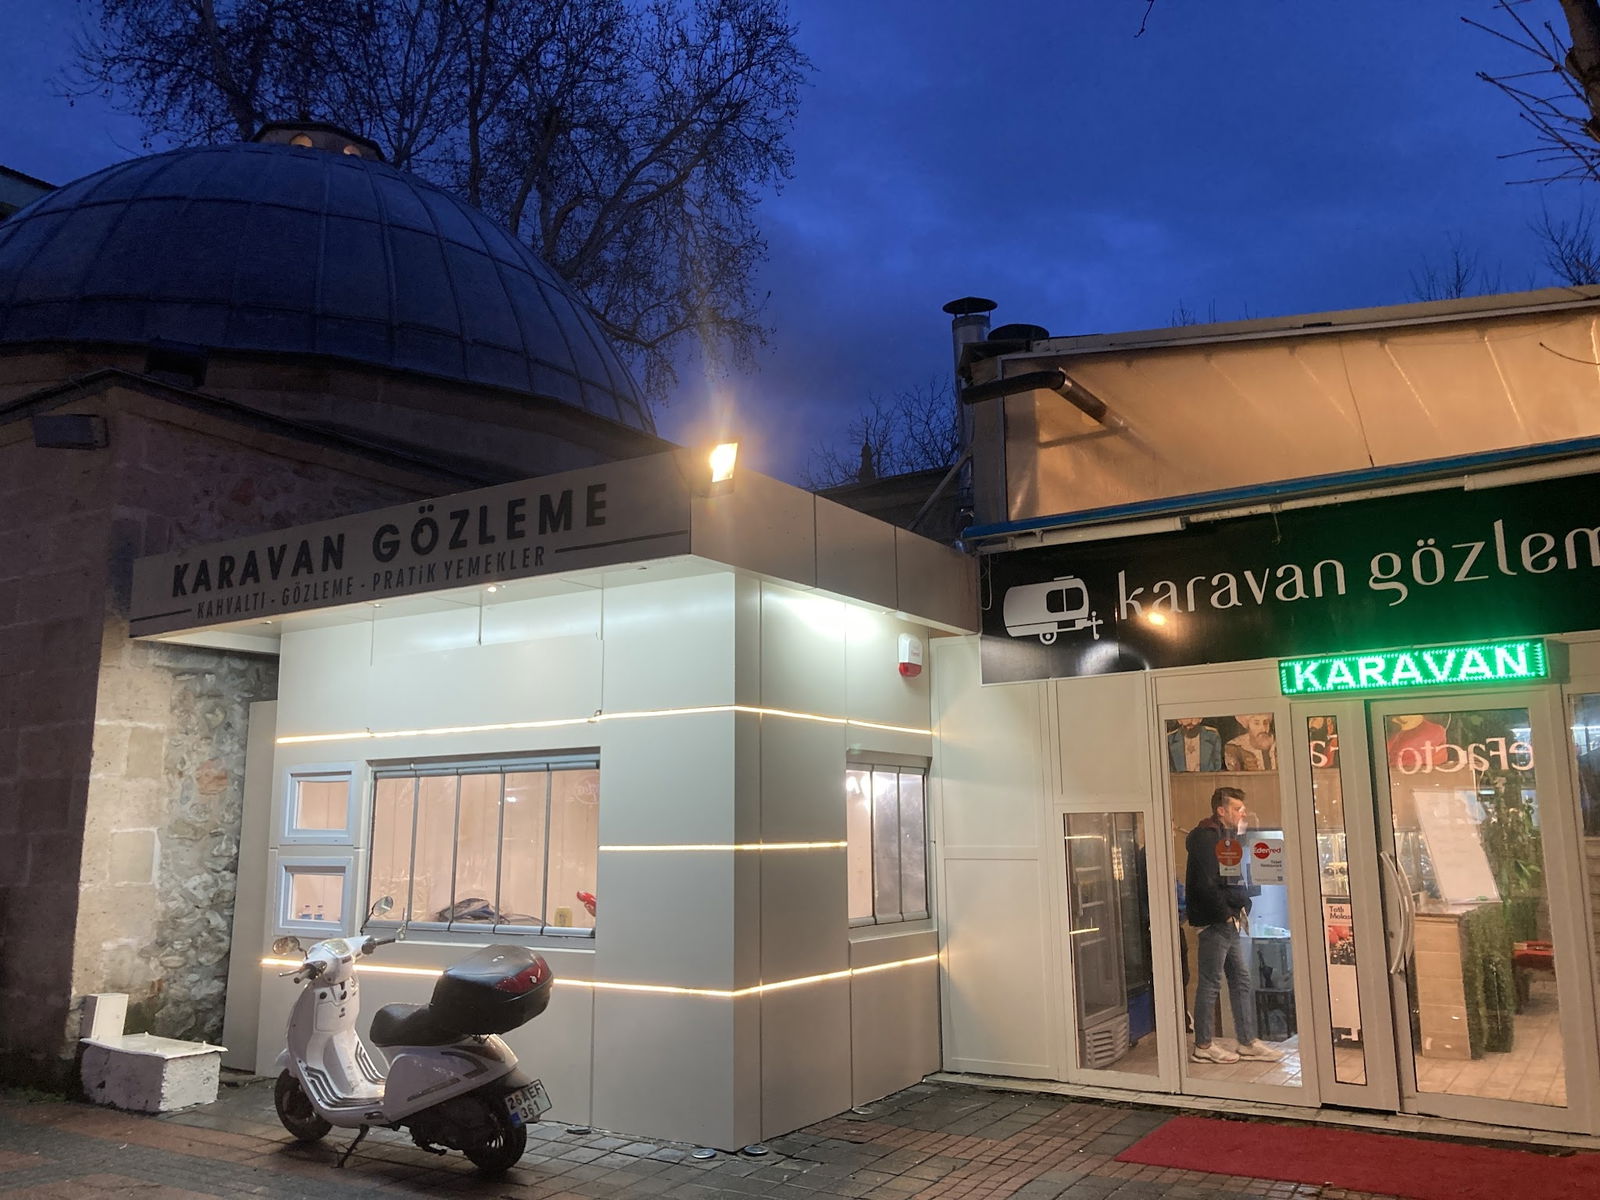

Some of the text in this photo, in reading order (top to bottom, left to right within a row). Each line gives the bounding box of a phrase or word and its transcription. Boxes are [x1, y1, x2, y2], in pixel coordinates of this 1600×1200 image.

[172, 483, 607, 597] KARAVAN GÖZLEME
[197, 591, 266, 619] KAHVALTI
[282, 575, 354, 606] GÖZLEME
[444, 546, 545, 580] YEMEKLER
[1118, 558, 1346, 620] karavan
[1294, 643, 1529, 690] KARAVAN
[521, 1100, 540, 1119] 361
